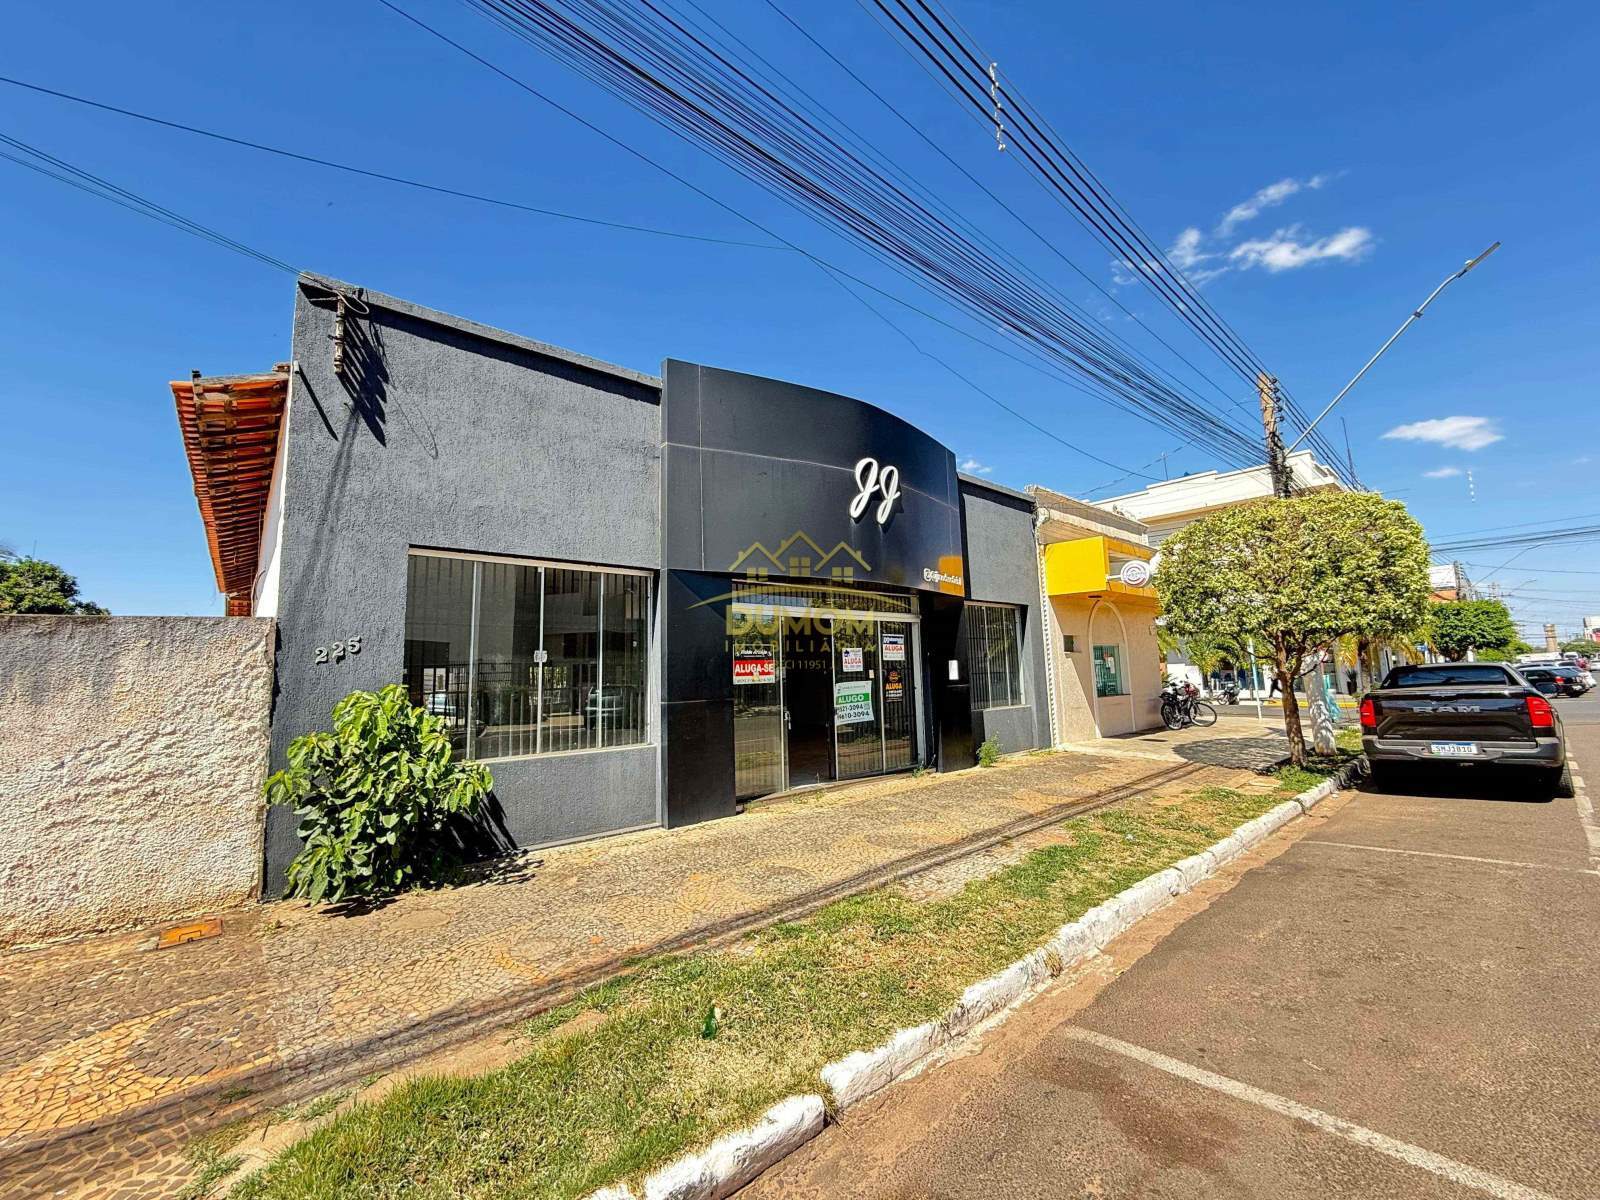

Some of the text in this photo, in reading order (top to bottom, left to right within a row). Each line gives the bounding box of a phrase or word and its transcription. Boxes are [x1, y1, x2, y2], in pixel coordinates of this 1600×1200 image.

[315, 636, 361, 664] 225
[844, 657, 862, 665] ALUGA
[735, 663, 774, 673] ALUGA-SE
[838, 694, 865, 704] ALUGO
[1412, 705, 1481, 713] RAM
